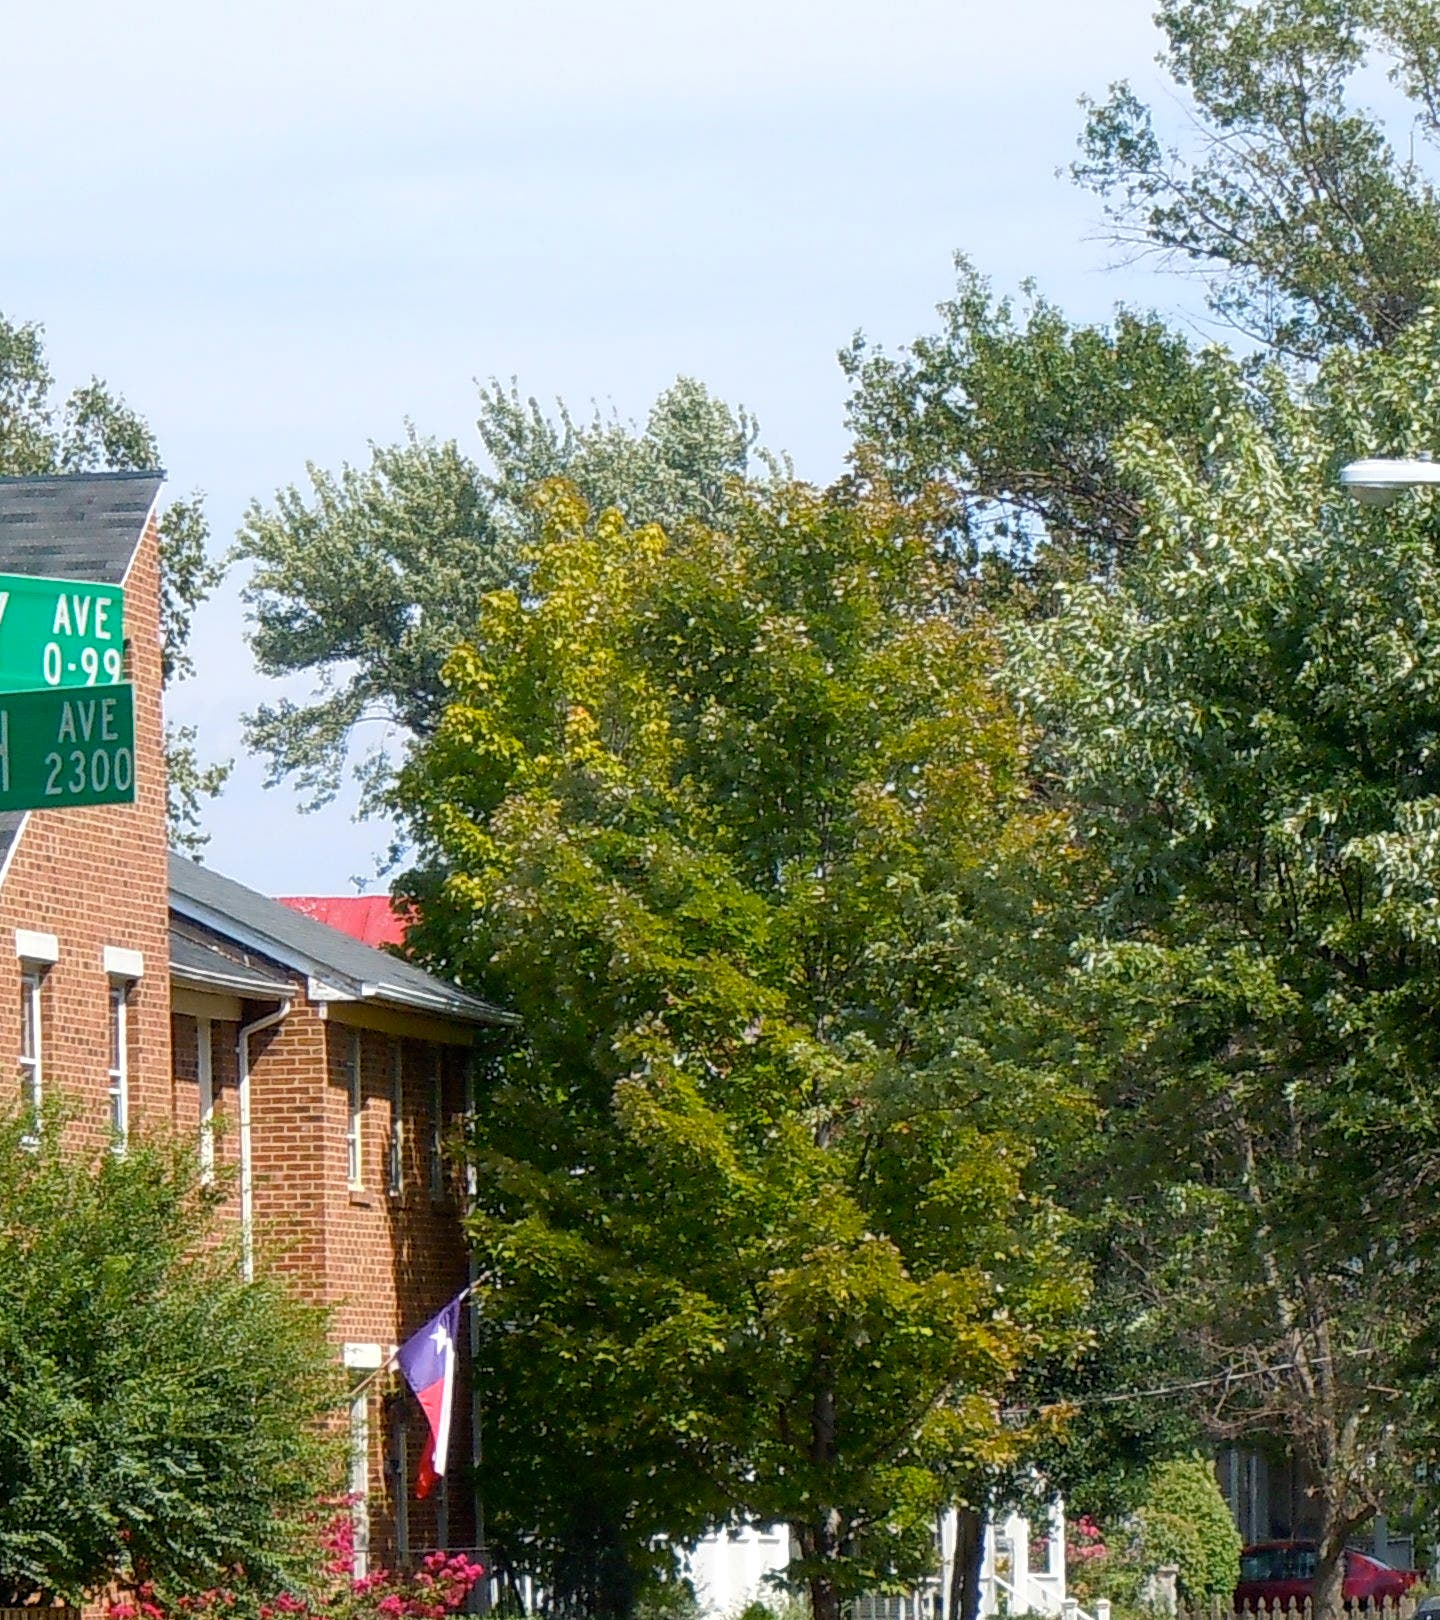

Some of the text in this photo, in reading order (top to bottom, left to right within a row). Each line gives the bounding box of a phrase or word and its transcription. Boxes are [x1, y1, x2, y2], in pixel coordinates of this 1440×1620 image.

[53, 593, 112, 640] AVE
[43, 642, 121, 685] 0-99
[58, 698, 119, 743] AVE
[44, 747, 132, 795] 2300
